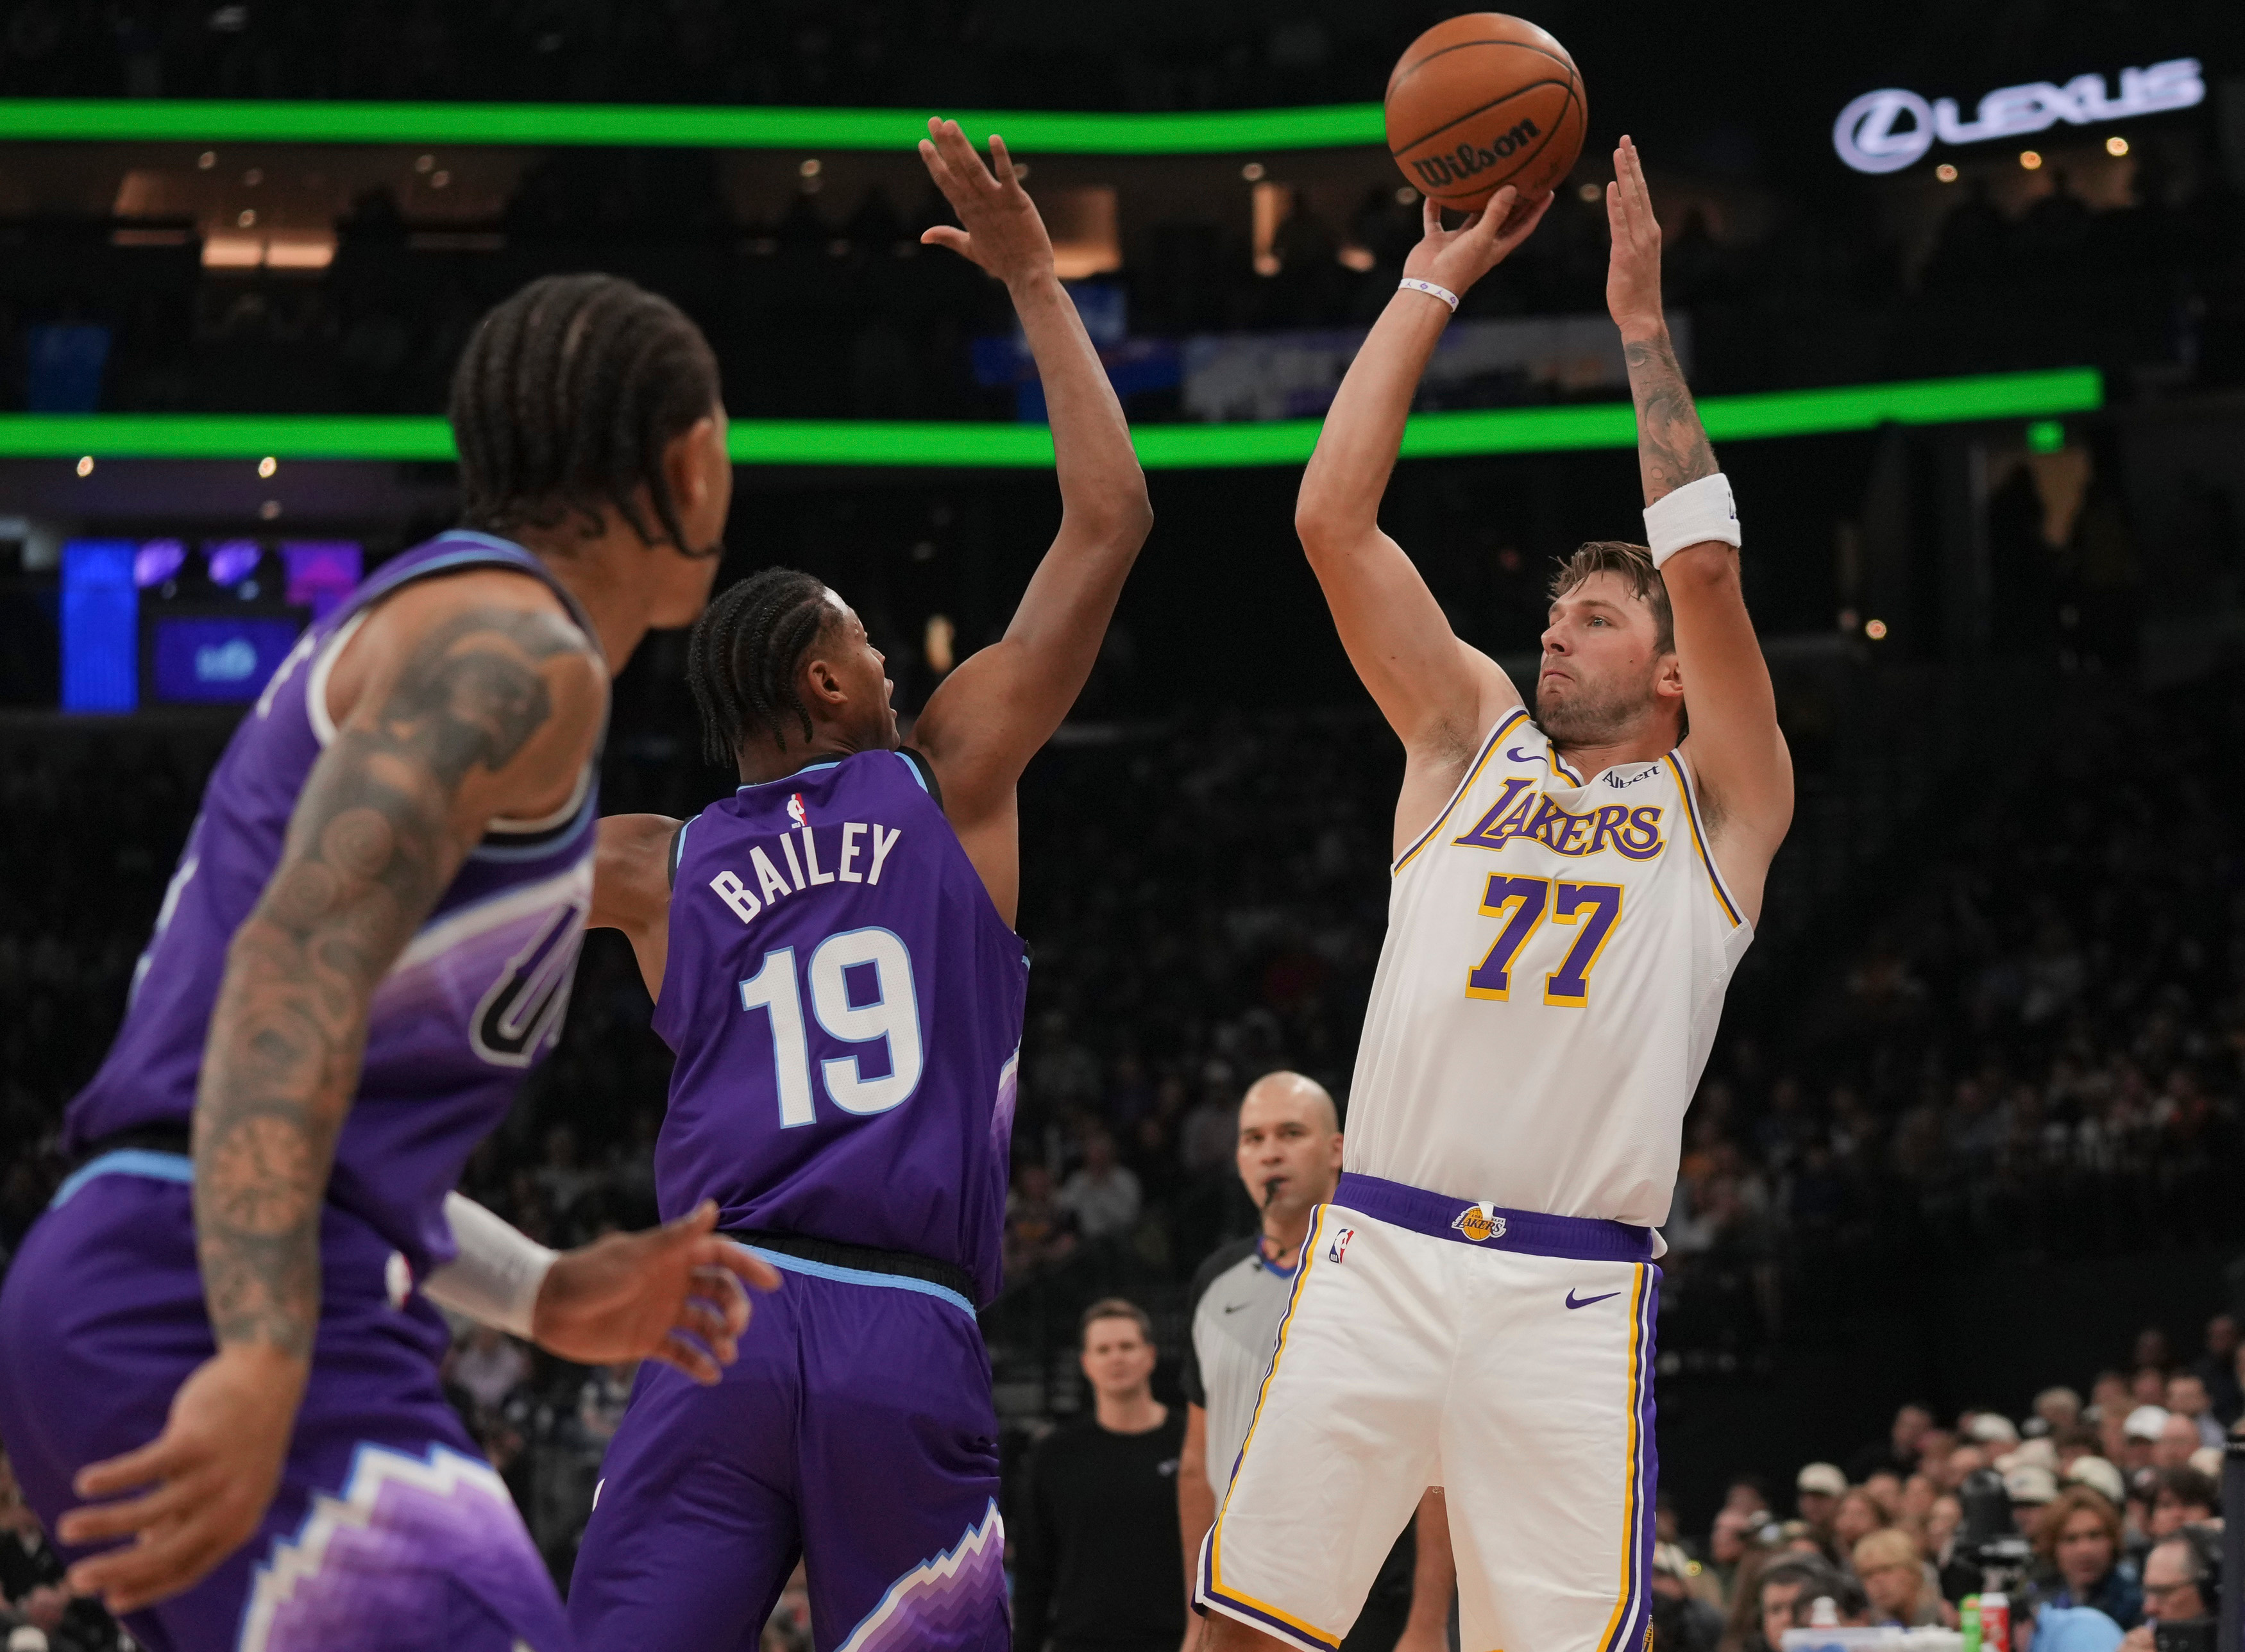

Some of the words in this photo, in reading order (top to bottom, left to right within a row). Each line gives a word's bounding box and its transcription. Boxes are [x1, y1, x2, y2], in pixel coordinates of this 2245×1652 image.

[1933, 57, 2205, 146] LEXUS
[1412, 118, 1541, 187] Wilson
[1450, 777, 1667, 862] LAKERS
[1602, 765, 1661, 789] Albert
[709, 822, 901, 924] BAILEY
[1465, 872, 1624, 1008] 77
[739, 925, 924, 1129] 19
[1453, 1212, 1504, 1236] LAKERS
